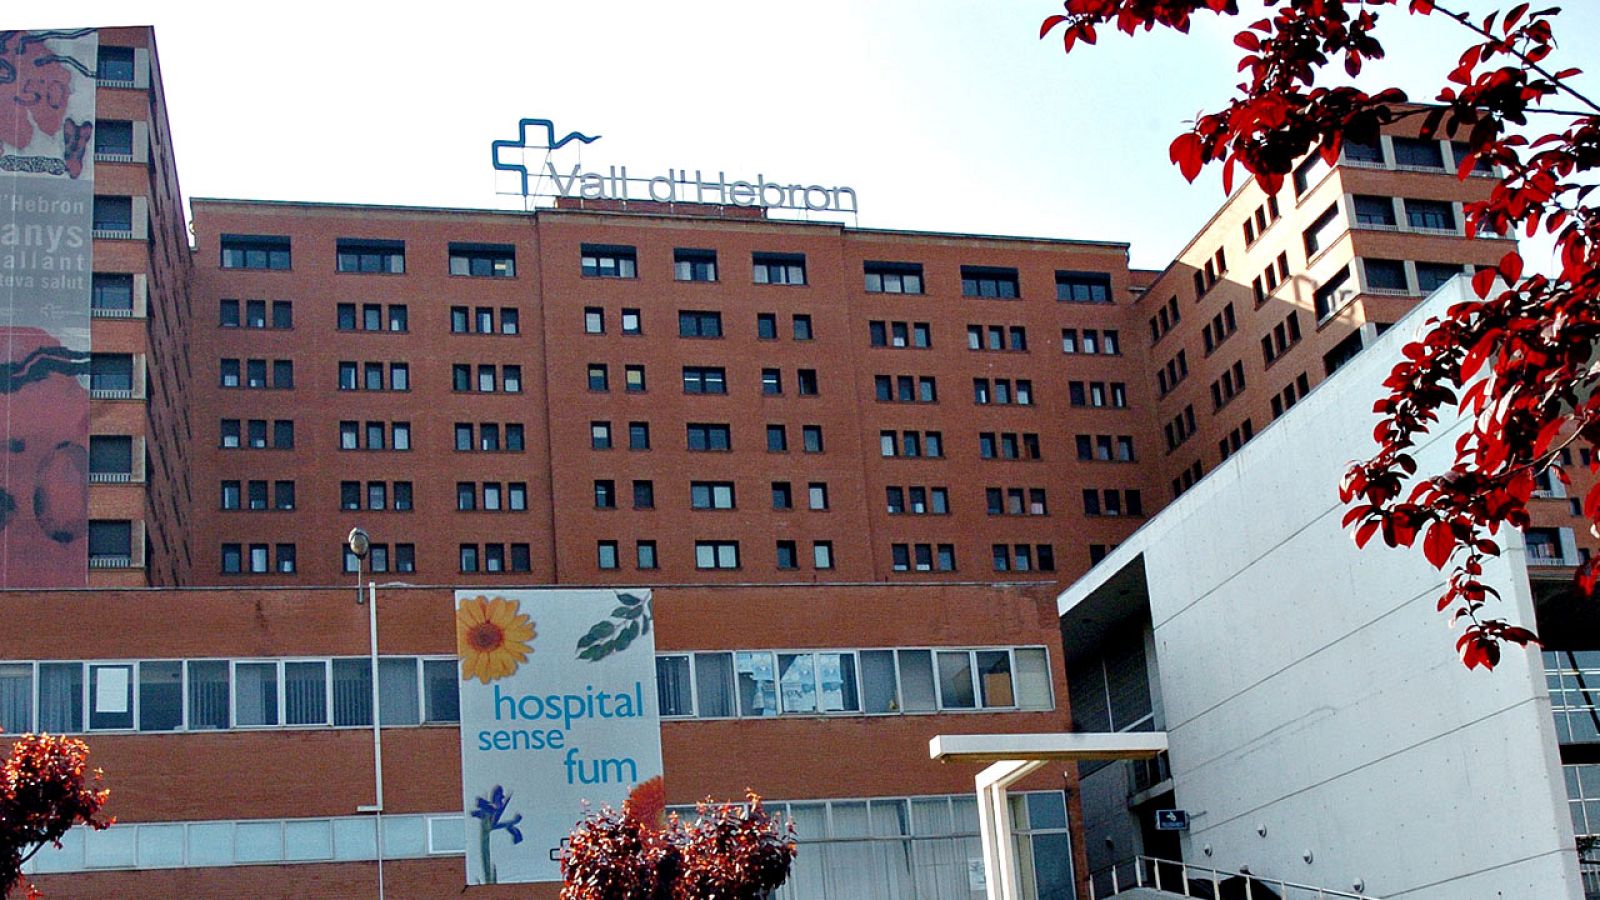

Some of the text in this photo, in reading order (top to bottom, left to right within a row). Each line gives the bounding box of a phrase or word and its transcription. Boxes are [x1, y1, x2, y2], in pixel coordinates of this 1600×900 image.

[546, 161, 858, 211] Vall d'Hebron
[0, 194, 84, 215] 'Hebron
[0, 223, 83, 253] anys
[40, 274, 84, 290] salut
[493, 681, 644, 730] hospital
[478, 728, 565, 751] sense
[563, 747, 637, 785] fum
